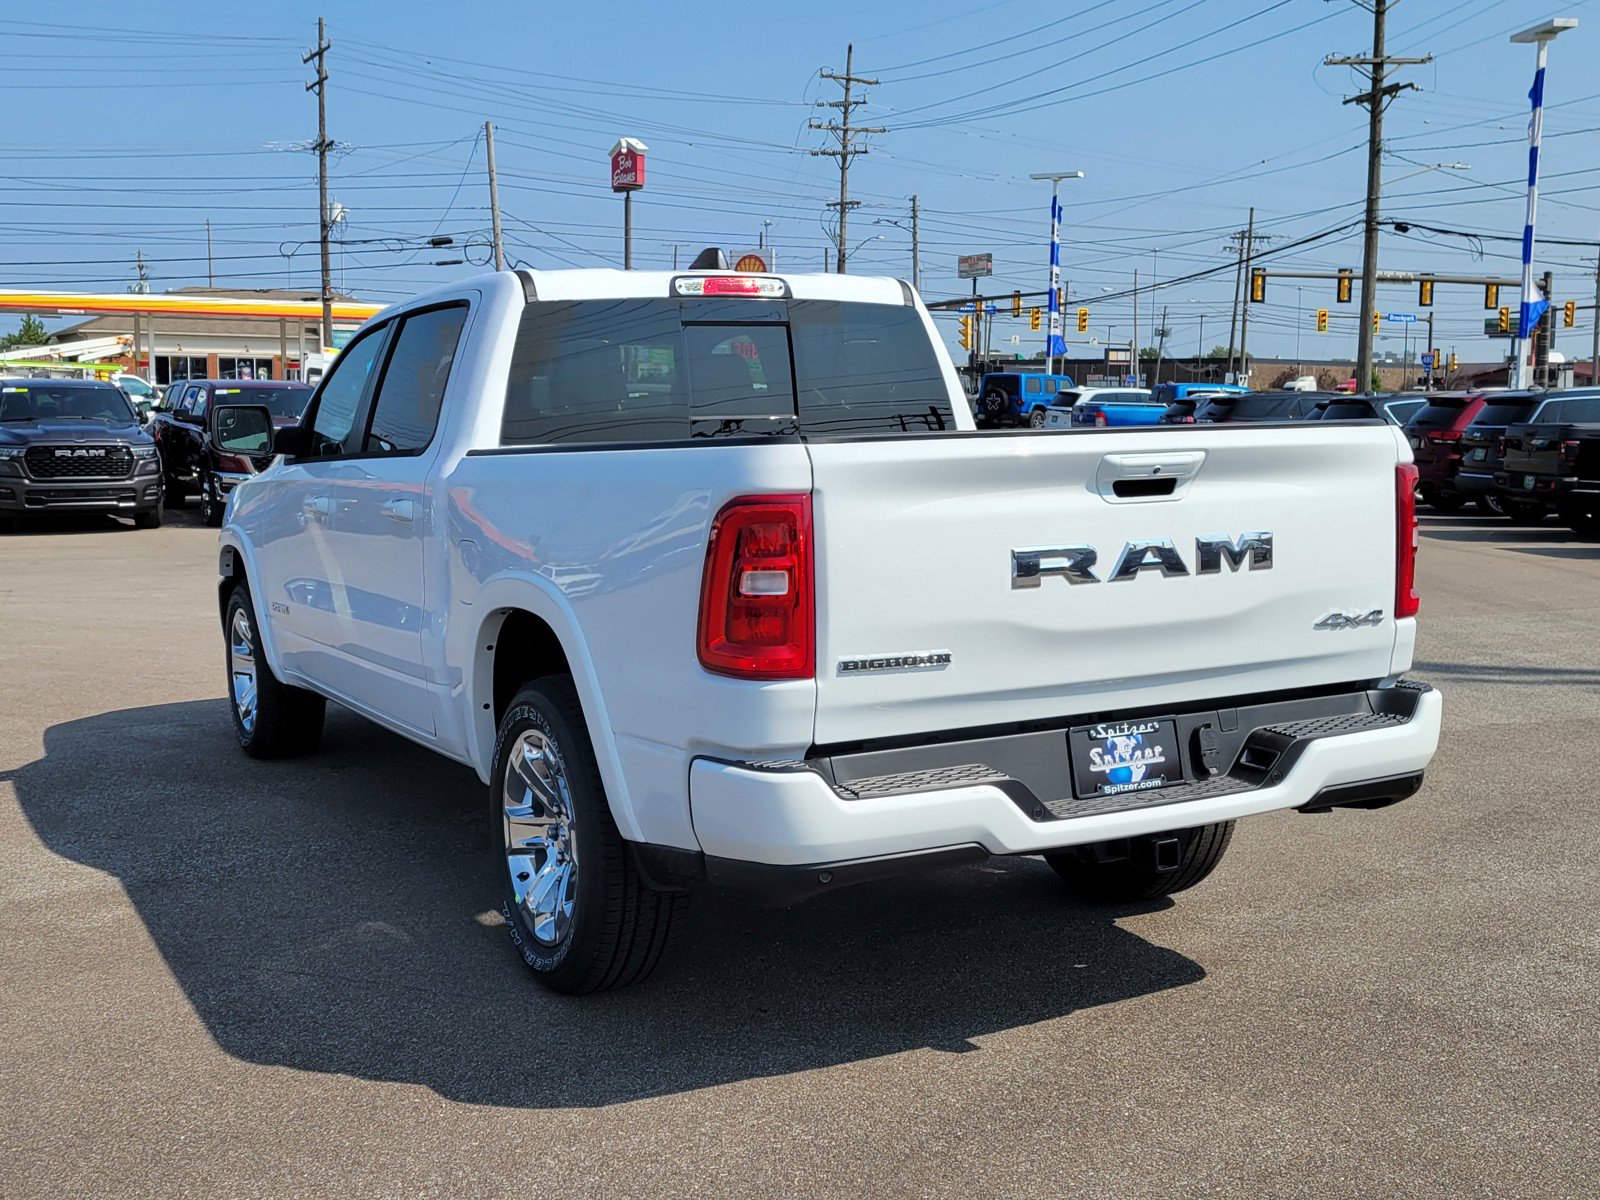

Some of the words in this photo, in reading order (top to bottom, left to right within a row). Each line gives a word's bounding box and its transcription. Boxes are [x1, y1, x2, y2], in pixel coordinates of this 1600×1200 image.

[617, 155, 632, 170] Bob
[613, 170, 636, 186] Evans
[54, 449, 106, 457] RAM
[1011, 531, 1273, 590] RAM
[1313, 609, 1385, 631] 4x4
[1096, 722, 1155, 739] Spitzer
[1089, 745, 1165, 774] Spitzer
[1104, 779, 1162, 795] Spitzer.com
